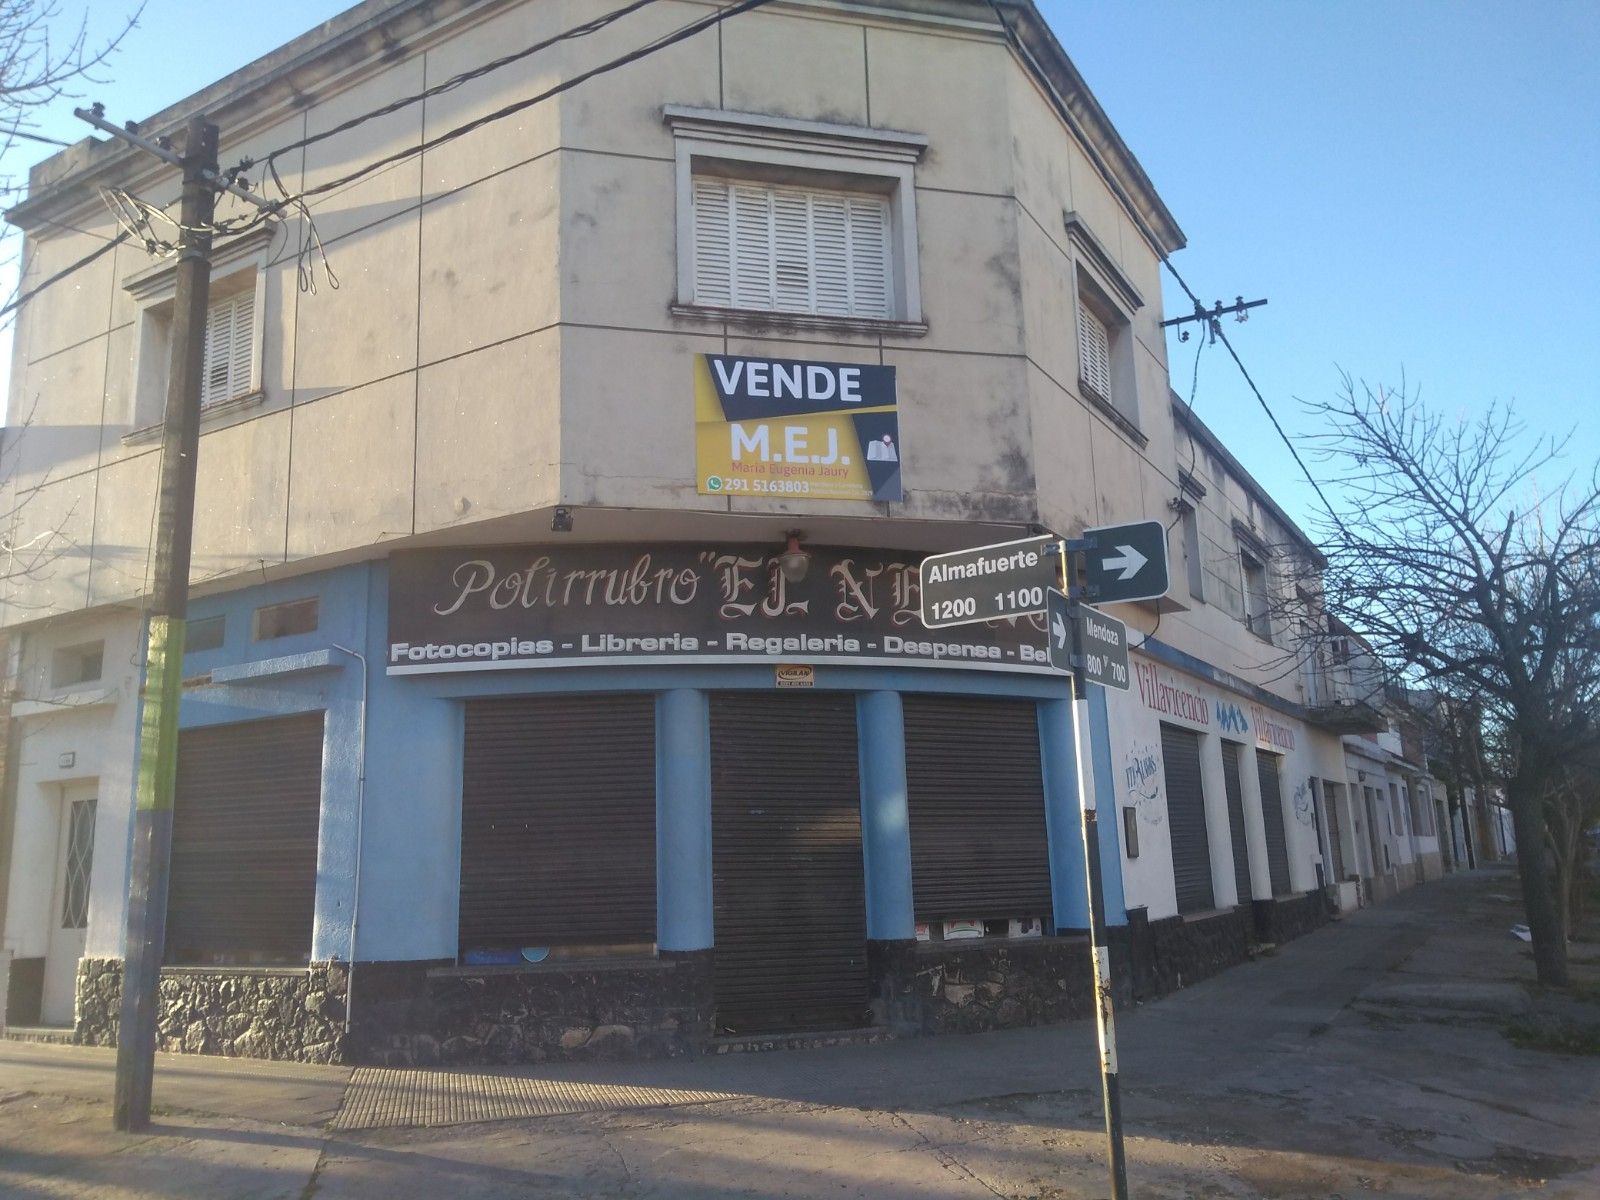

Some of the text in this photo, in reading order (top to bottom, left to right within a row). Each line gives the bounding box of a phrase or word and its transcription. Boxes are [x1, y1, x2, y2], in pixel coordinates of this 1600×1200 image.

[714, 359, 862, 402] VENDE
[730, 423, 851, 465] M.E.J.
[724, 478, 749, 491] 291
[753, 479, 810, 493] 5163803
[769, 464, 815, 477] Eugenia
[818, 467, 849, 479] Jaury
[928, 551, 1039, 584] Almafuerte
[434, 553, 701, 616] Polirrubro
[931, 586, 1044, 621] 1200 1100
[391, 637, 554, 662] Fotocopias
[581, 633, 699, 652] Libreria
[726, 632, 861, 655] Regaleria
[884, 636, 1001, 660] Despensa
[1086, 616, 1120, 646] Mendoza
[1087, 653, 1126, 683] 800 700
[1134, 661, 1209, 725] Villavicencio
